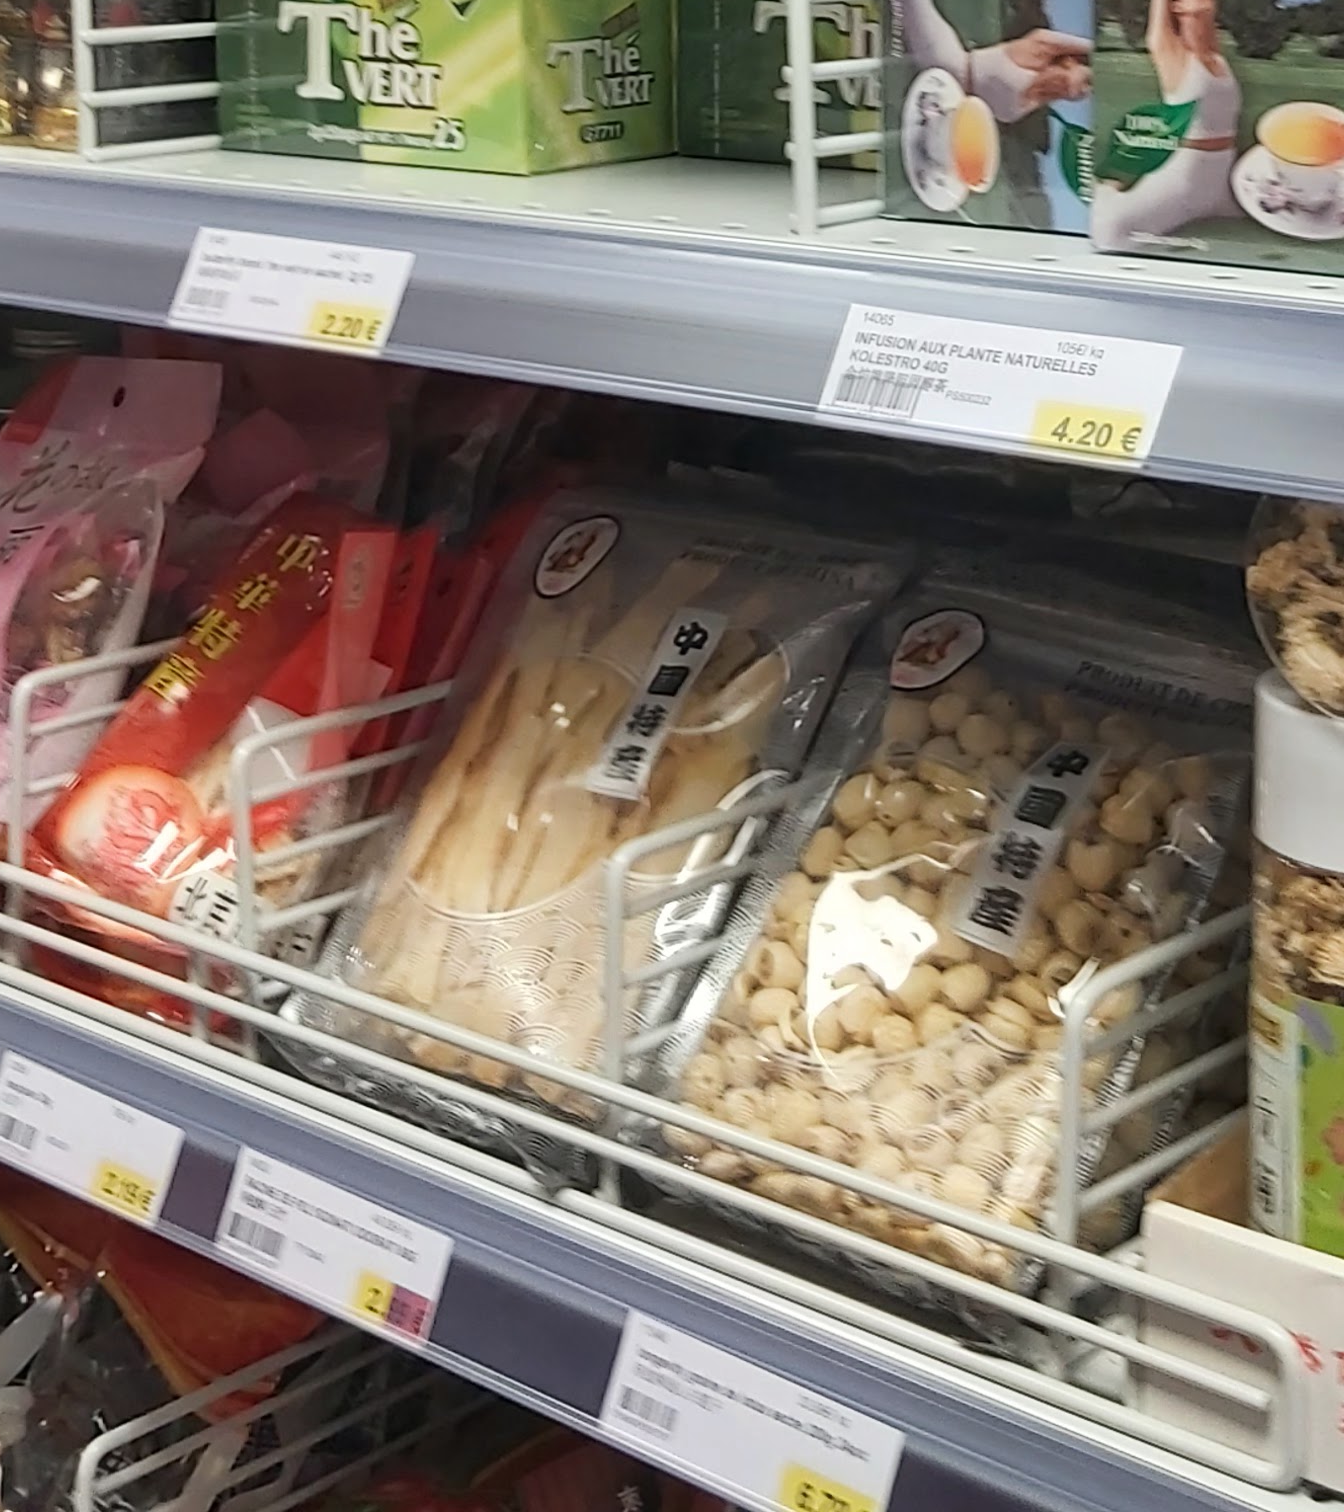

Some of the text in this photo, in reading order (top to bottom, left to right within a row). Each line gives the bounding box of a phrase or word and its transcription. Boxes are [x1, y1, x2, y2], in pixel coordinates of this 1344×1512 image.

[340, 59, 444, 110] VERT
[545, 31, 641, 116] Thé
[595, 70, 656, 110] VERT
[320, 313, 383, 342] 2.20 €
[848, 348, 950, 375] KOLESTRO 40G
[854, 330, 1099, 378] INFUSION AUX PLANTE NATURELLES
[1050, 415, 1143, 453] 4.20 €
